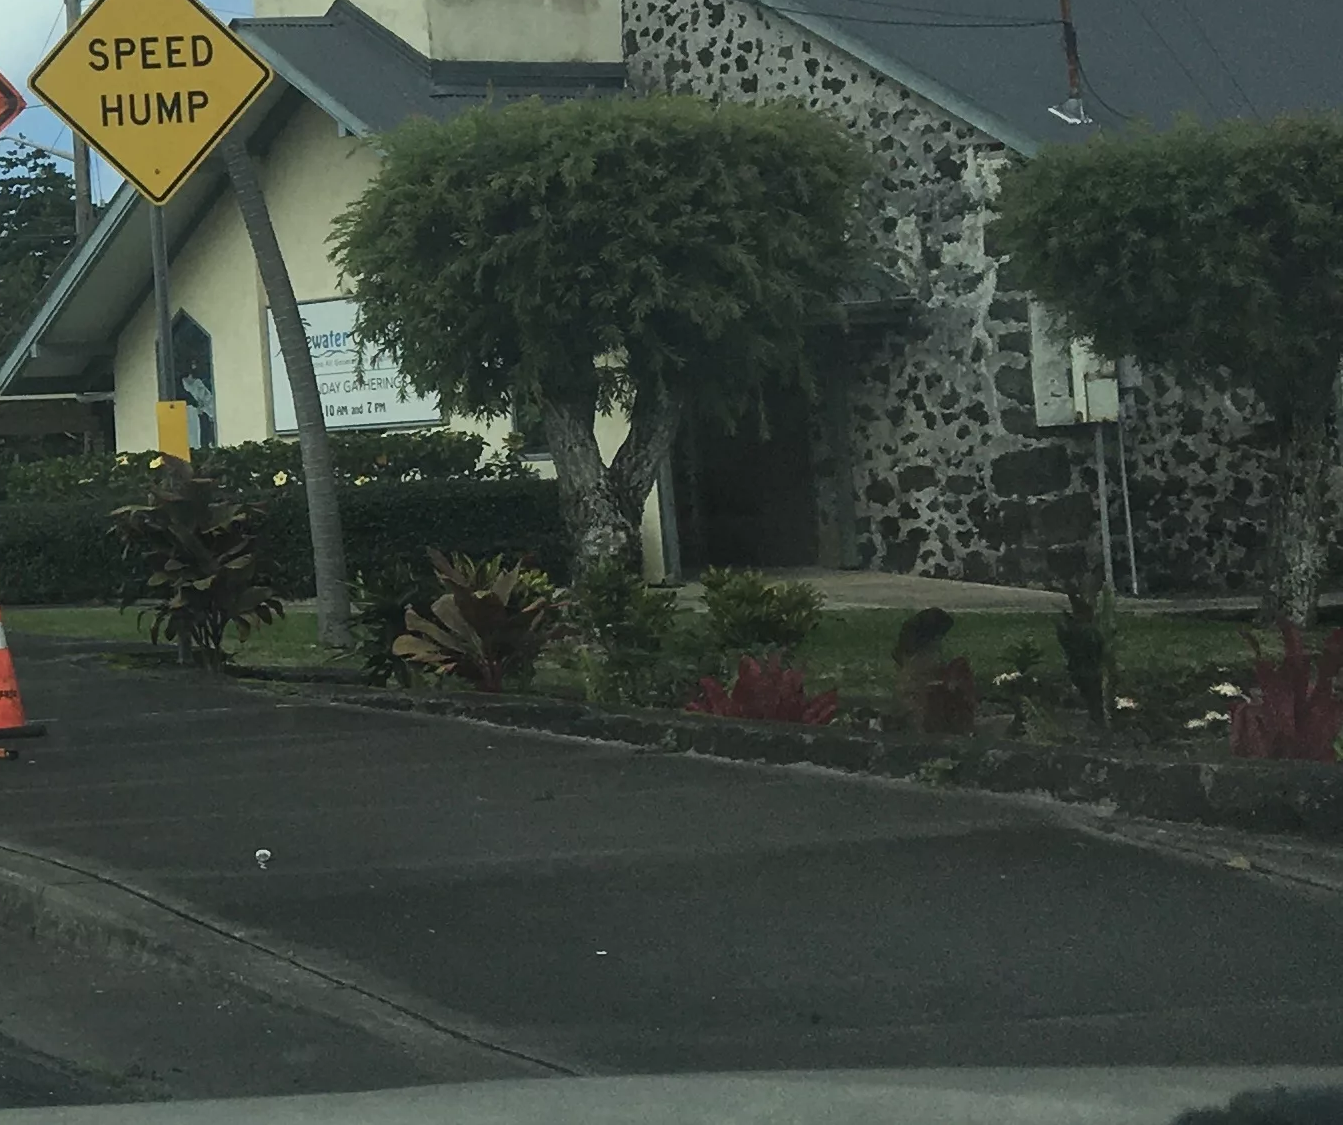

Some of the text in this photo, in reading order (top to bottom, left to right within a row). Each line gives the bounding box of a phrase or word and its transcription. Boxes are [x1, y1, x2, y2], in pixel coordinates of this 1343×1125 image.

[88, 34, 214, 72] SPEED
[100, 90, 209, 127] HUMP
[306, 331, 349, 349] ewater
[325, 404, 335, 417] 10
[337, 406, 348, 416] AM
[367, 402, 373, 414] 7
[374, 402, 387, 413] PM
